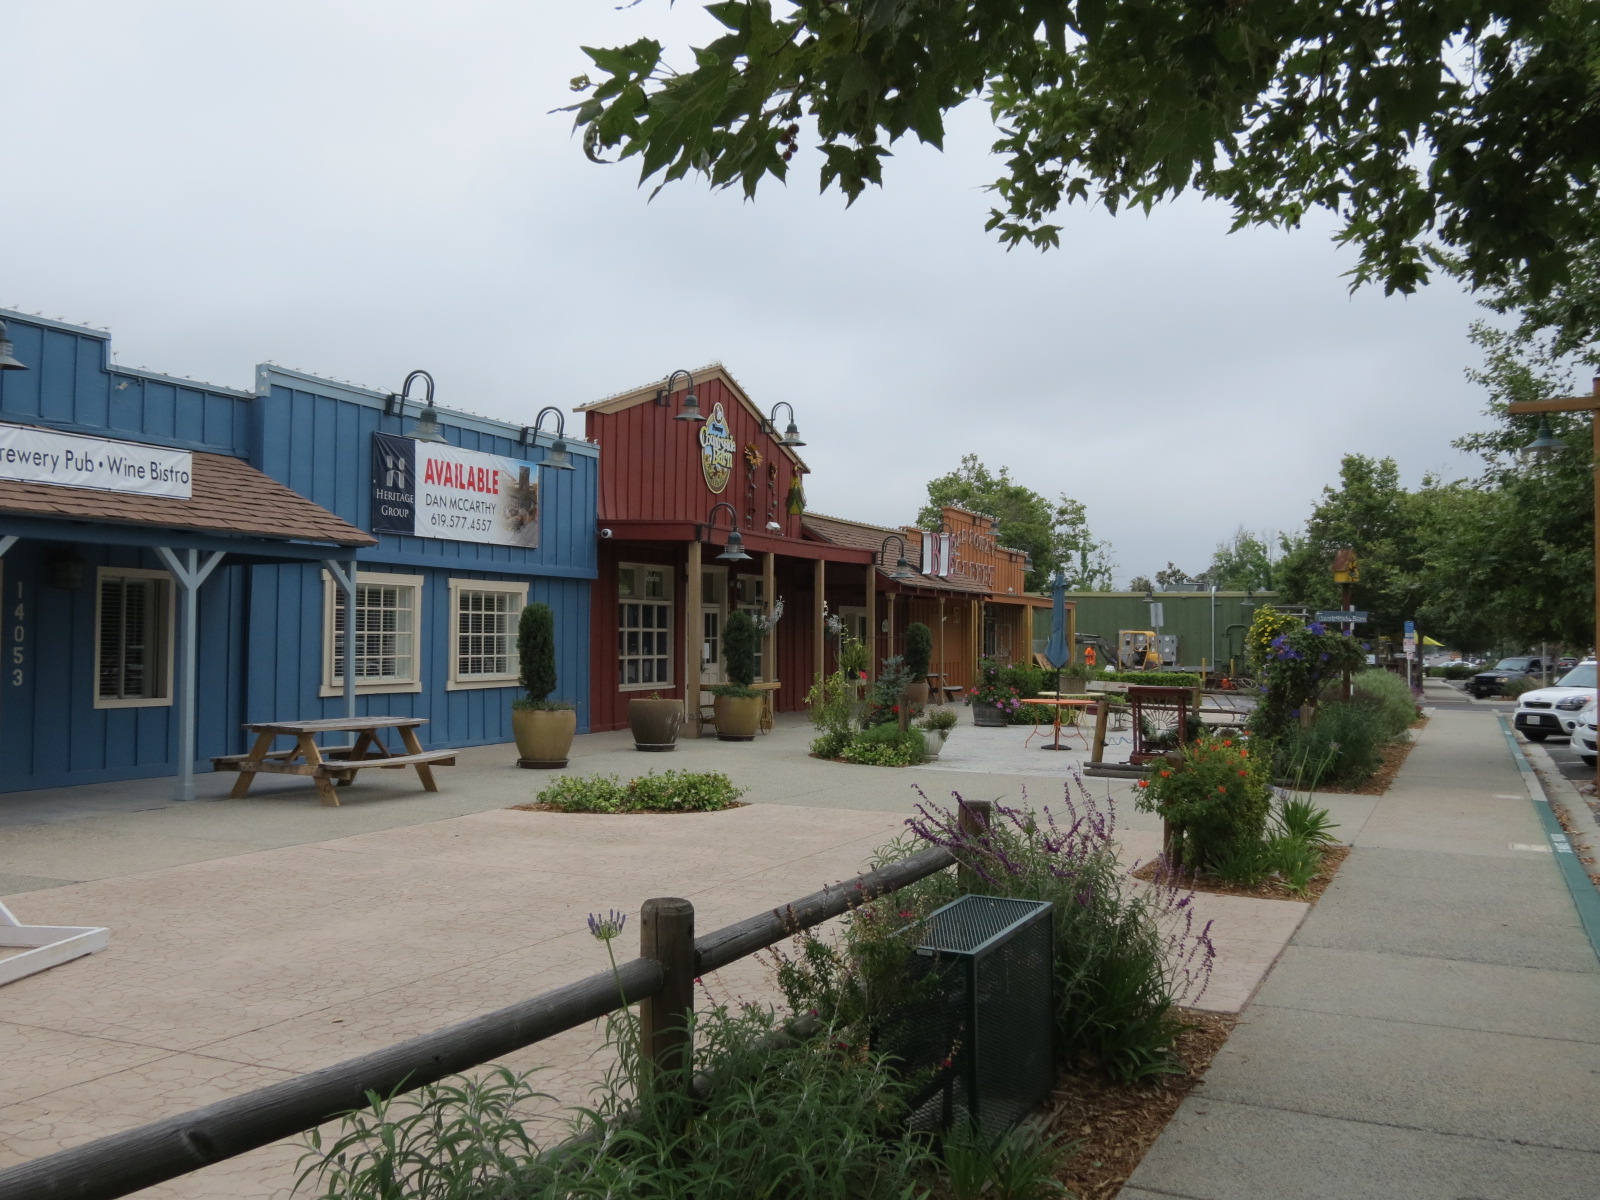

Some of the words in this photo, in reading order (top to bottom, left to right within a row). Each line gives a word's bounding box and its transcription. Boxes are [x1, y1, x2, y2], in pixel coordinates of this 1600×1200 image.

[65, 450, 94, 472] Pub
[107, 455, 146, 479] Wine
[150, 461, 189, 484] Bistro
[713, 447, 732, 468] Barn
[424, 458, 499, 495] AVAILABLE
[376, 489, 414, 504] HERITAGE
[426, 494, 447, 508] DAN
[450, 499, 496, 515] MCCARTHY
[381, 505, 409, 518] GROUP
[431, 513, 492, 532] 619.577.4557
[13, 581, 24, 686] 14053
